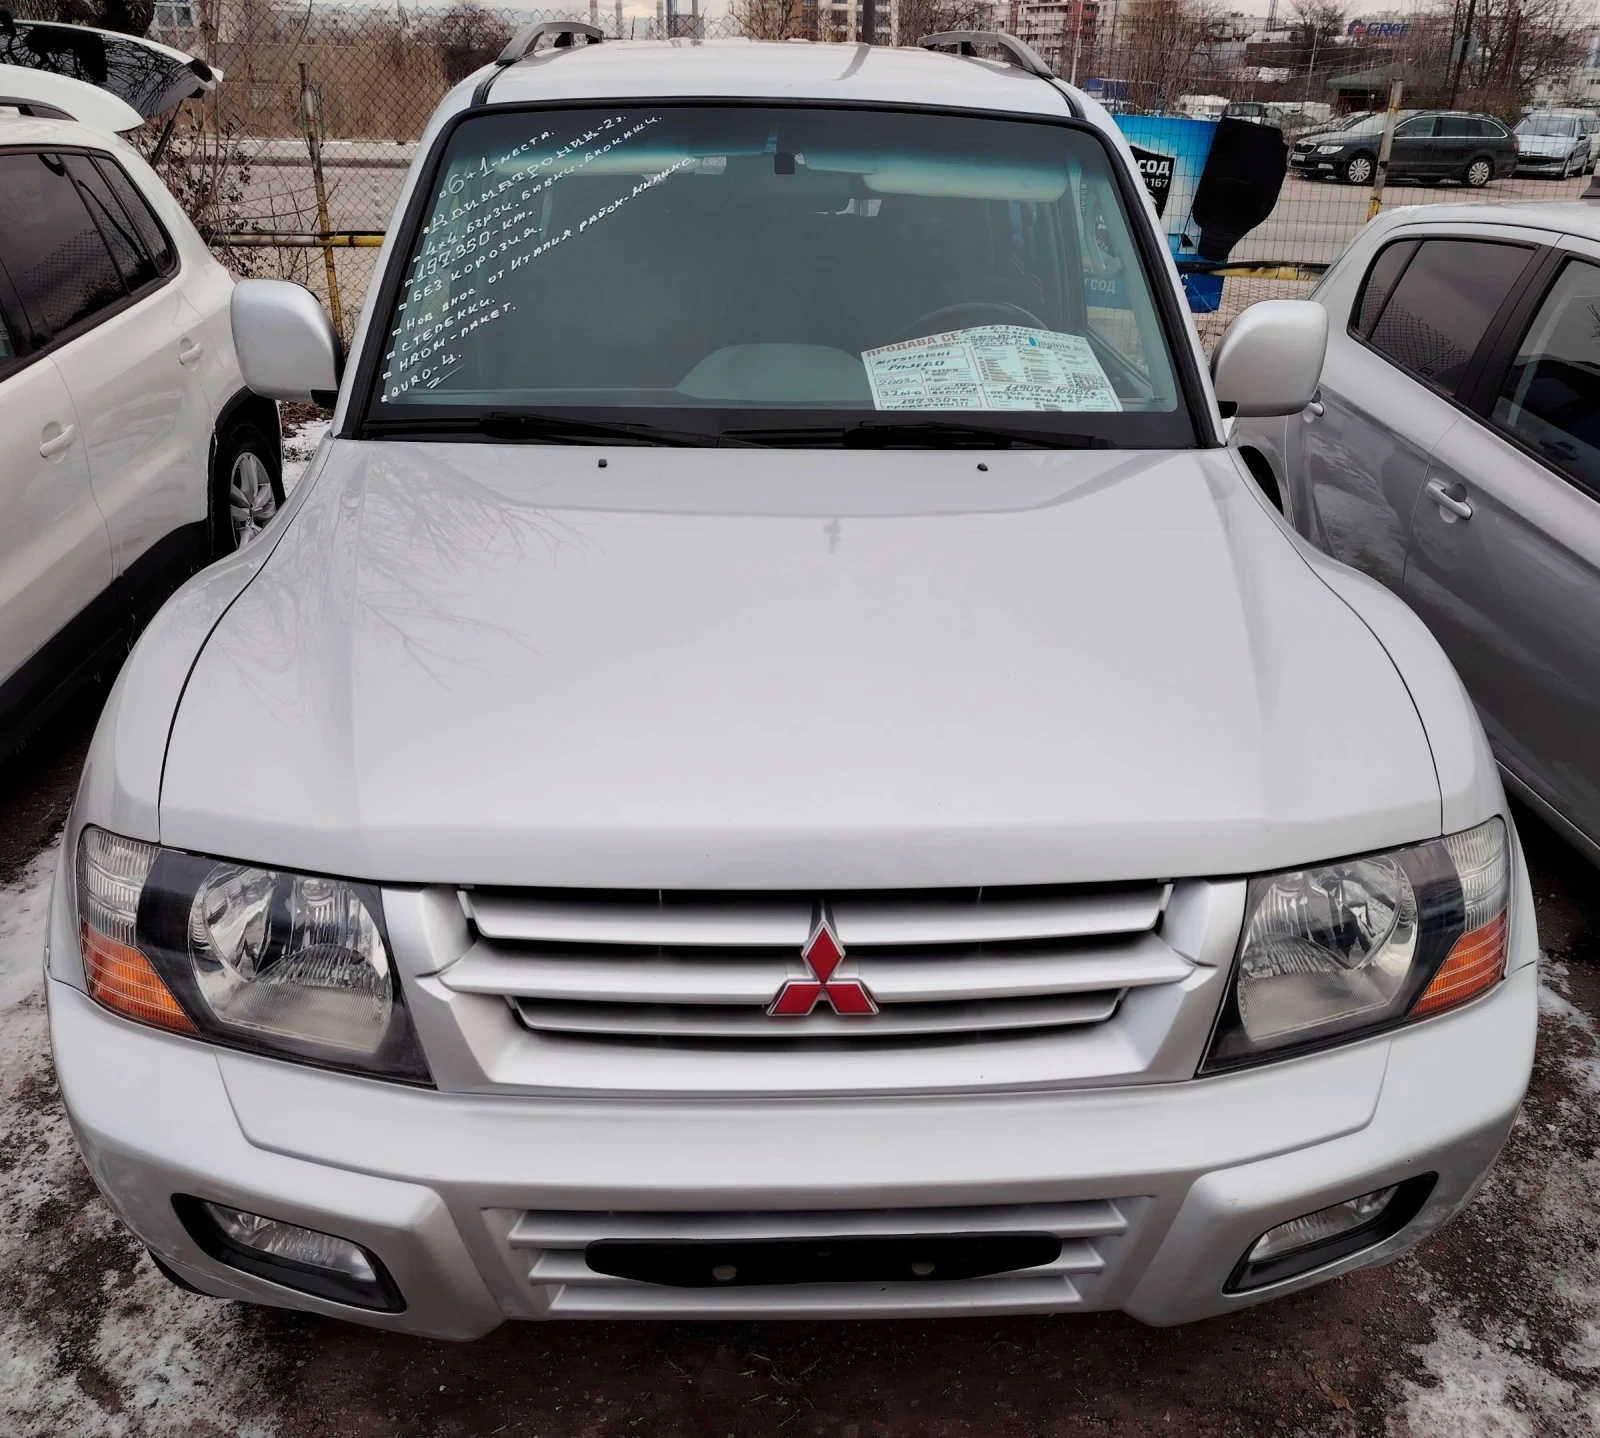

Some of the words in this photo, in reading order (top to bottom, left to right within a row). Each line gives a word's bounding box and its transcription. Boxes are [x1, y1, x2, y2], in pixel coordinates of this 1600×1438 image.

[1137, 159, 1170, 177] СОД
[1150, 178, 1169, 188] 167
[413, 280, 443, 302] БЕЗ
[1090, 279, 1116, 295] СОД
[866, 334, 937, 358] ПРОДАВА
[940, 332, 961, 343] СЕ
[887, 360, 945, 371] PAJERO
